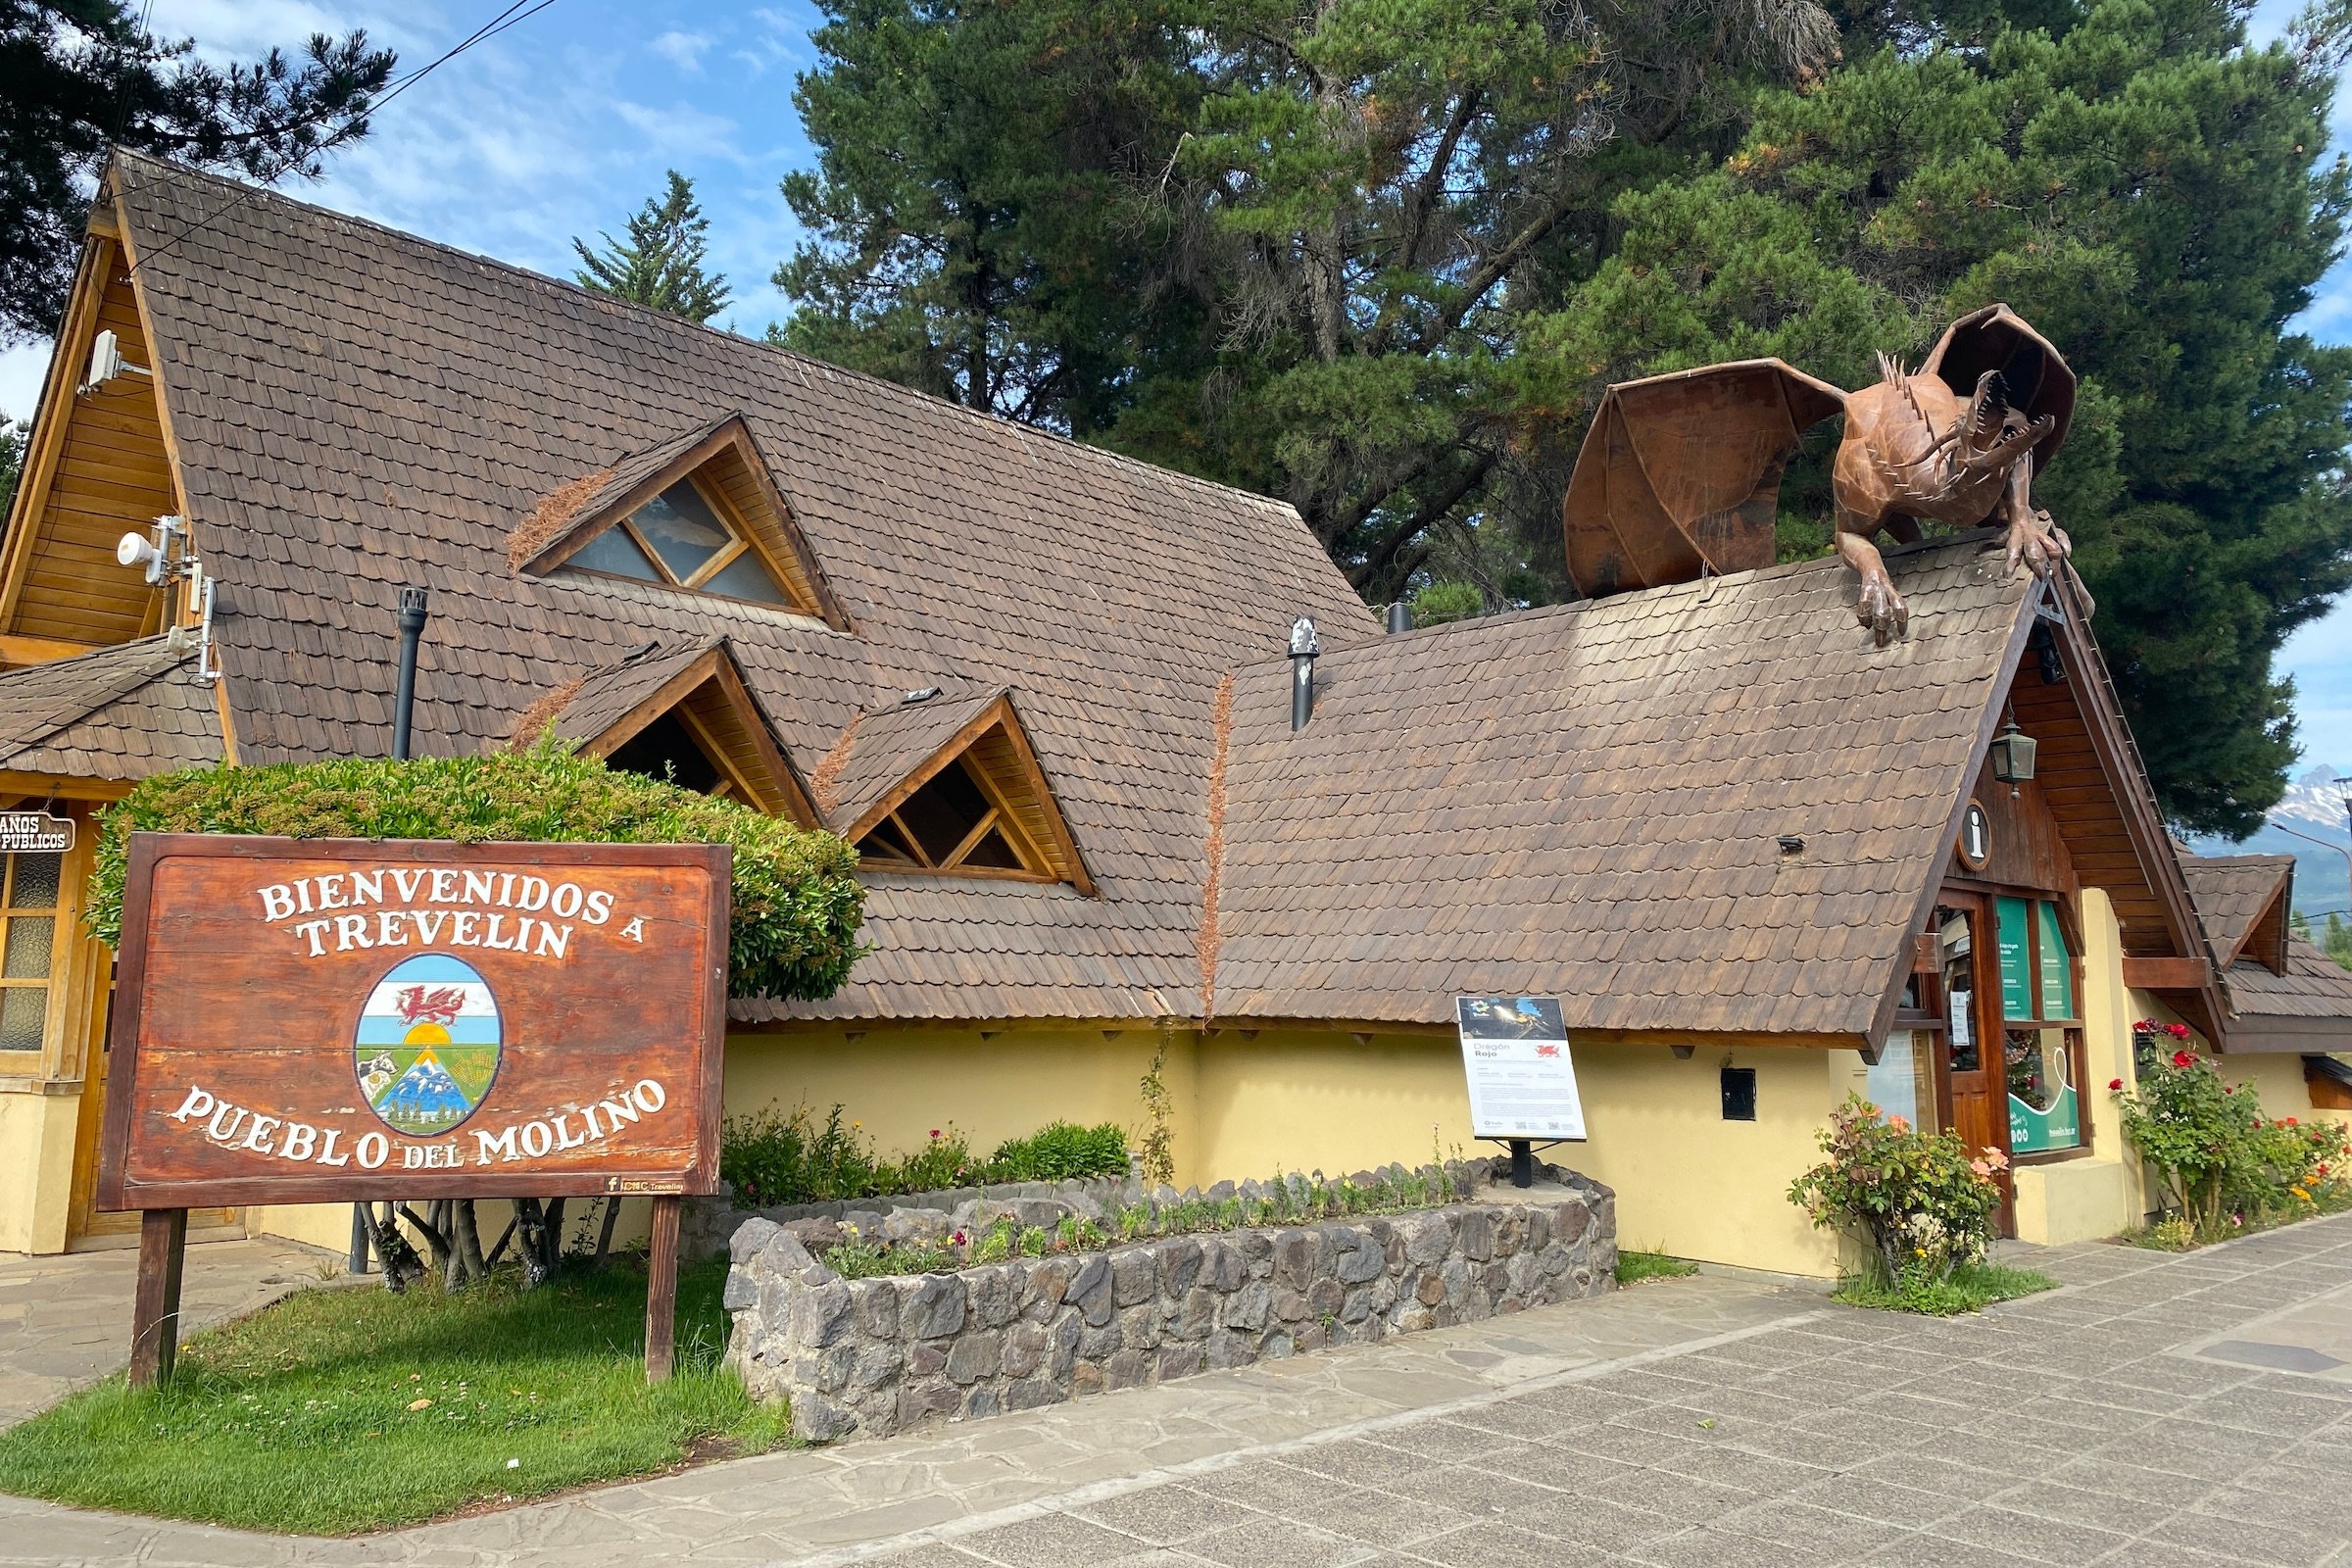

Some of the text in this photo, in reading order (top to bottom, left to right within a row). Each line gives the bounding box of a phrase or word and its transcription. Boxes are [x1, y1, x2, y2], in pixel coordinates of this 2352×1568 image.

[257, 868, 645, 943] BIENVENIDOS A
[296, 910, 574, 959] TREVELIN
[171, 1078, 667, 1170] PUEBLO DEL MOLINO
